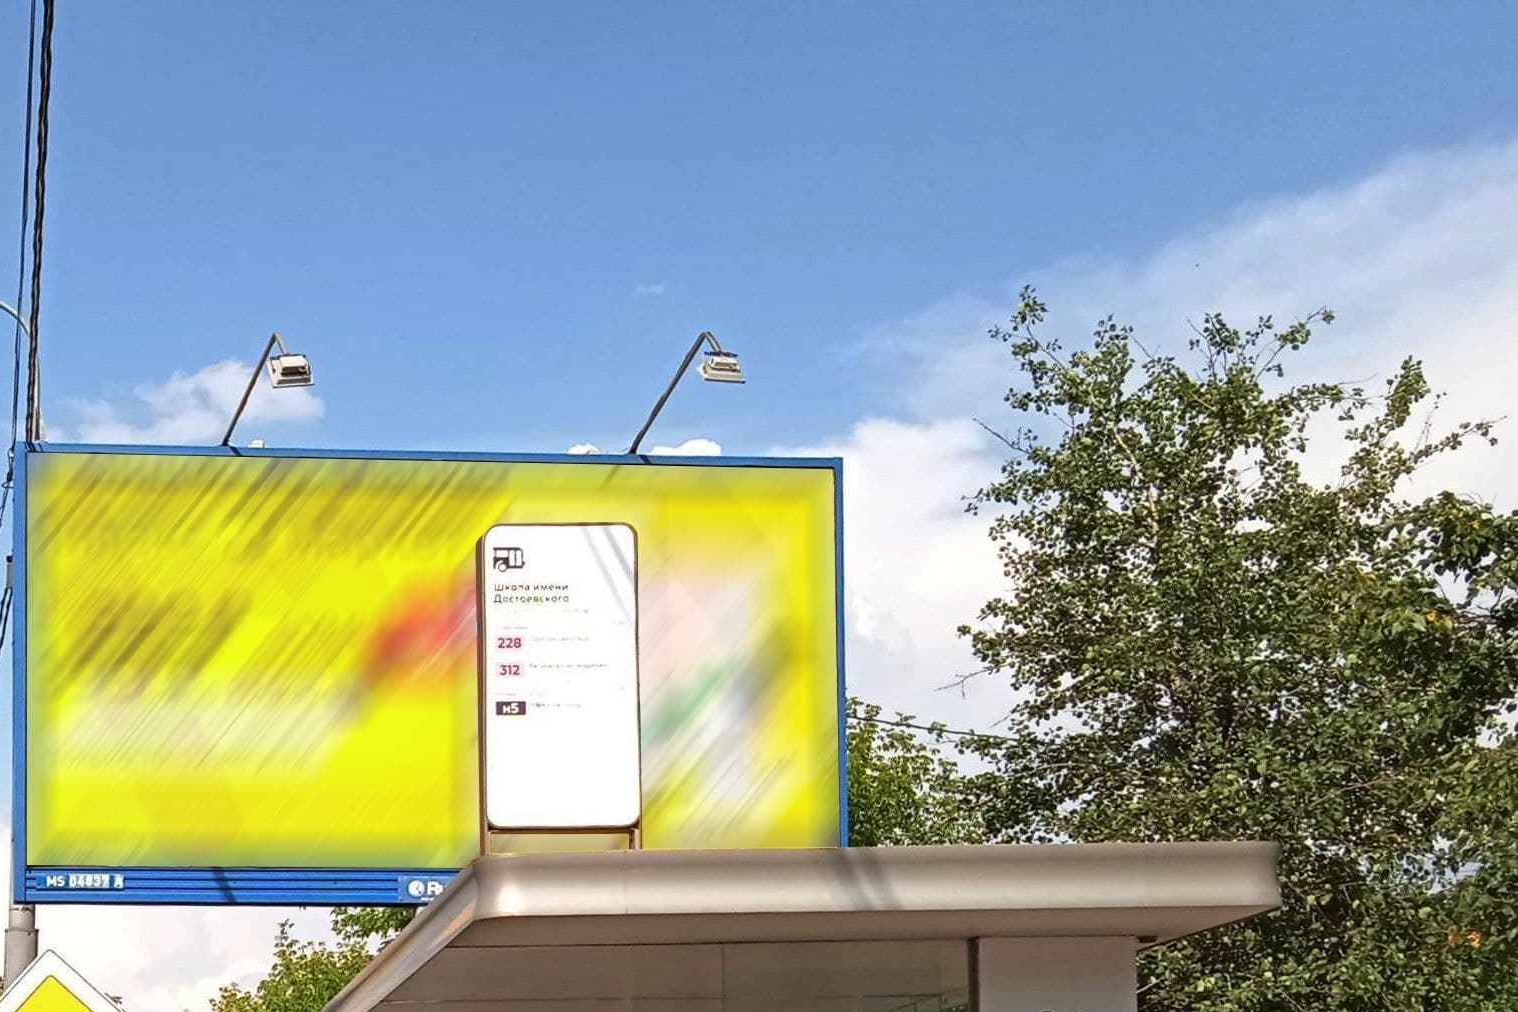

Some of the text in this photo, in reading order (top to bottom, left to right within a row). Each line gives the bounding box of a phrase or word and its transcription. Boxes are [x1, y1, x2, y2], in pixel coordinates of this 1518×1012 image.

[493, 582, 569, 592] Школа имени
[493, 593, 570, 604] Достоевского
[497, 637, 522, 649] 228
[499, 664, 521, 676] 312
[46, 875, 66, 888] MS
